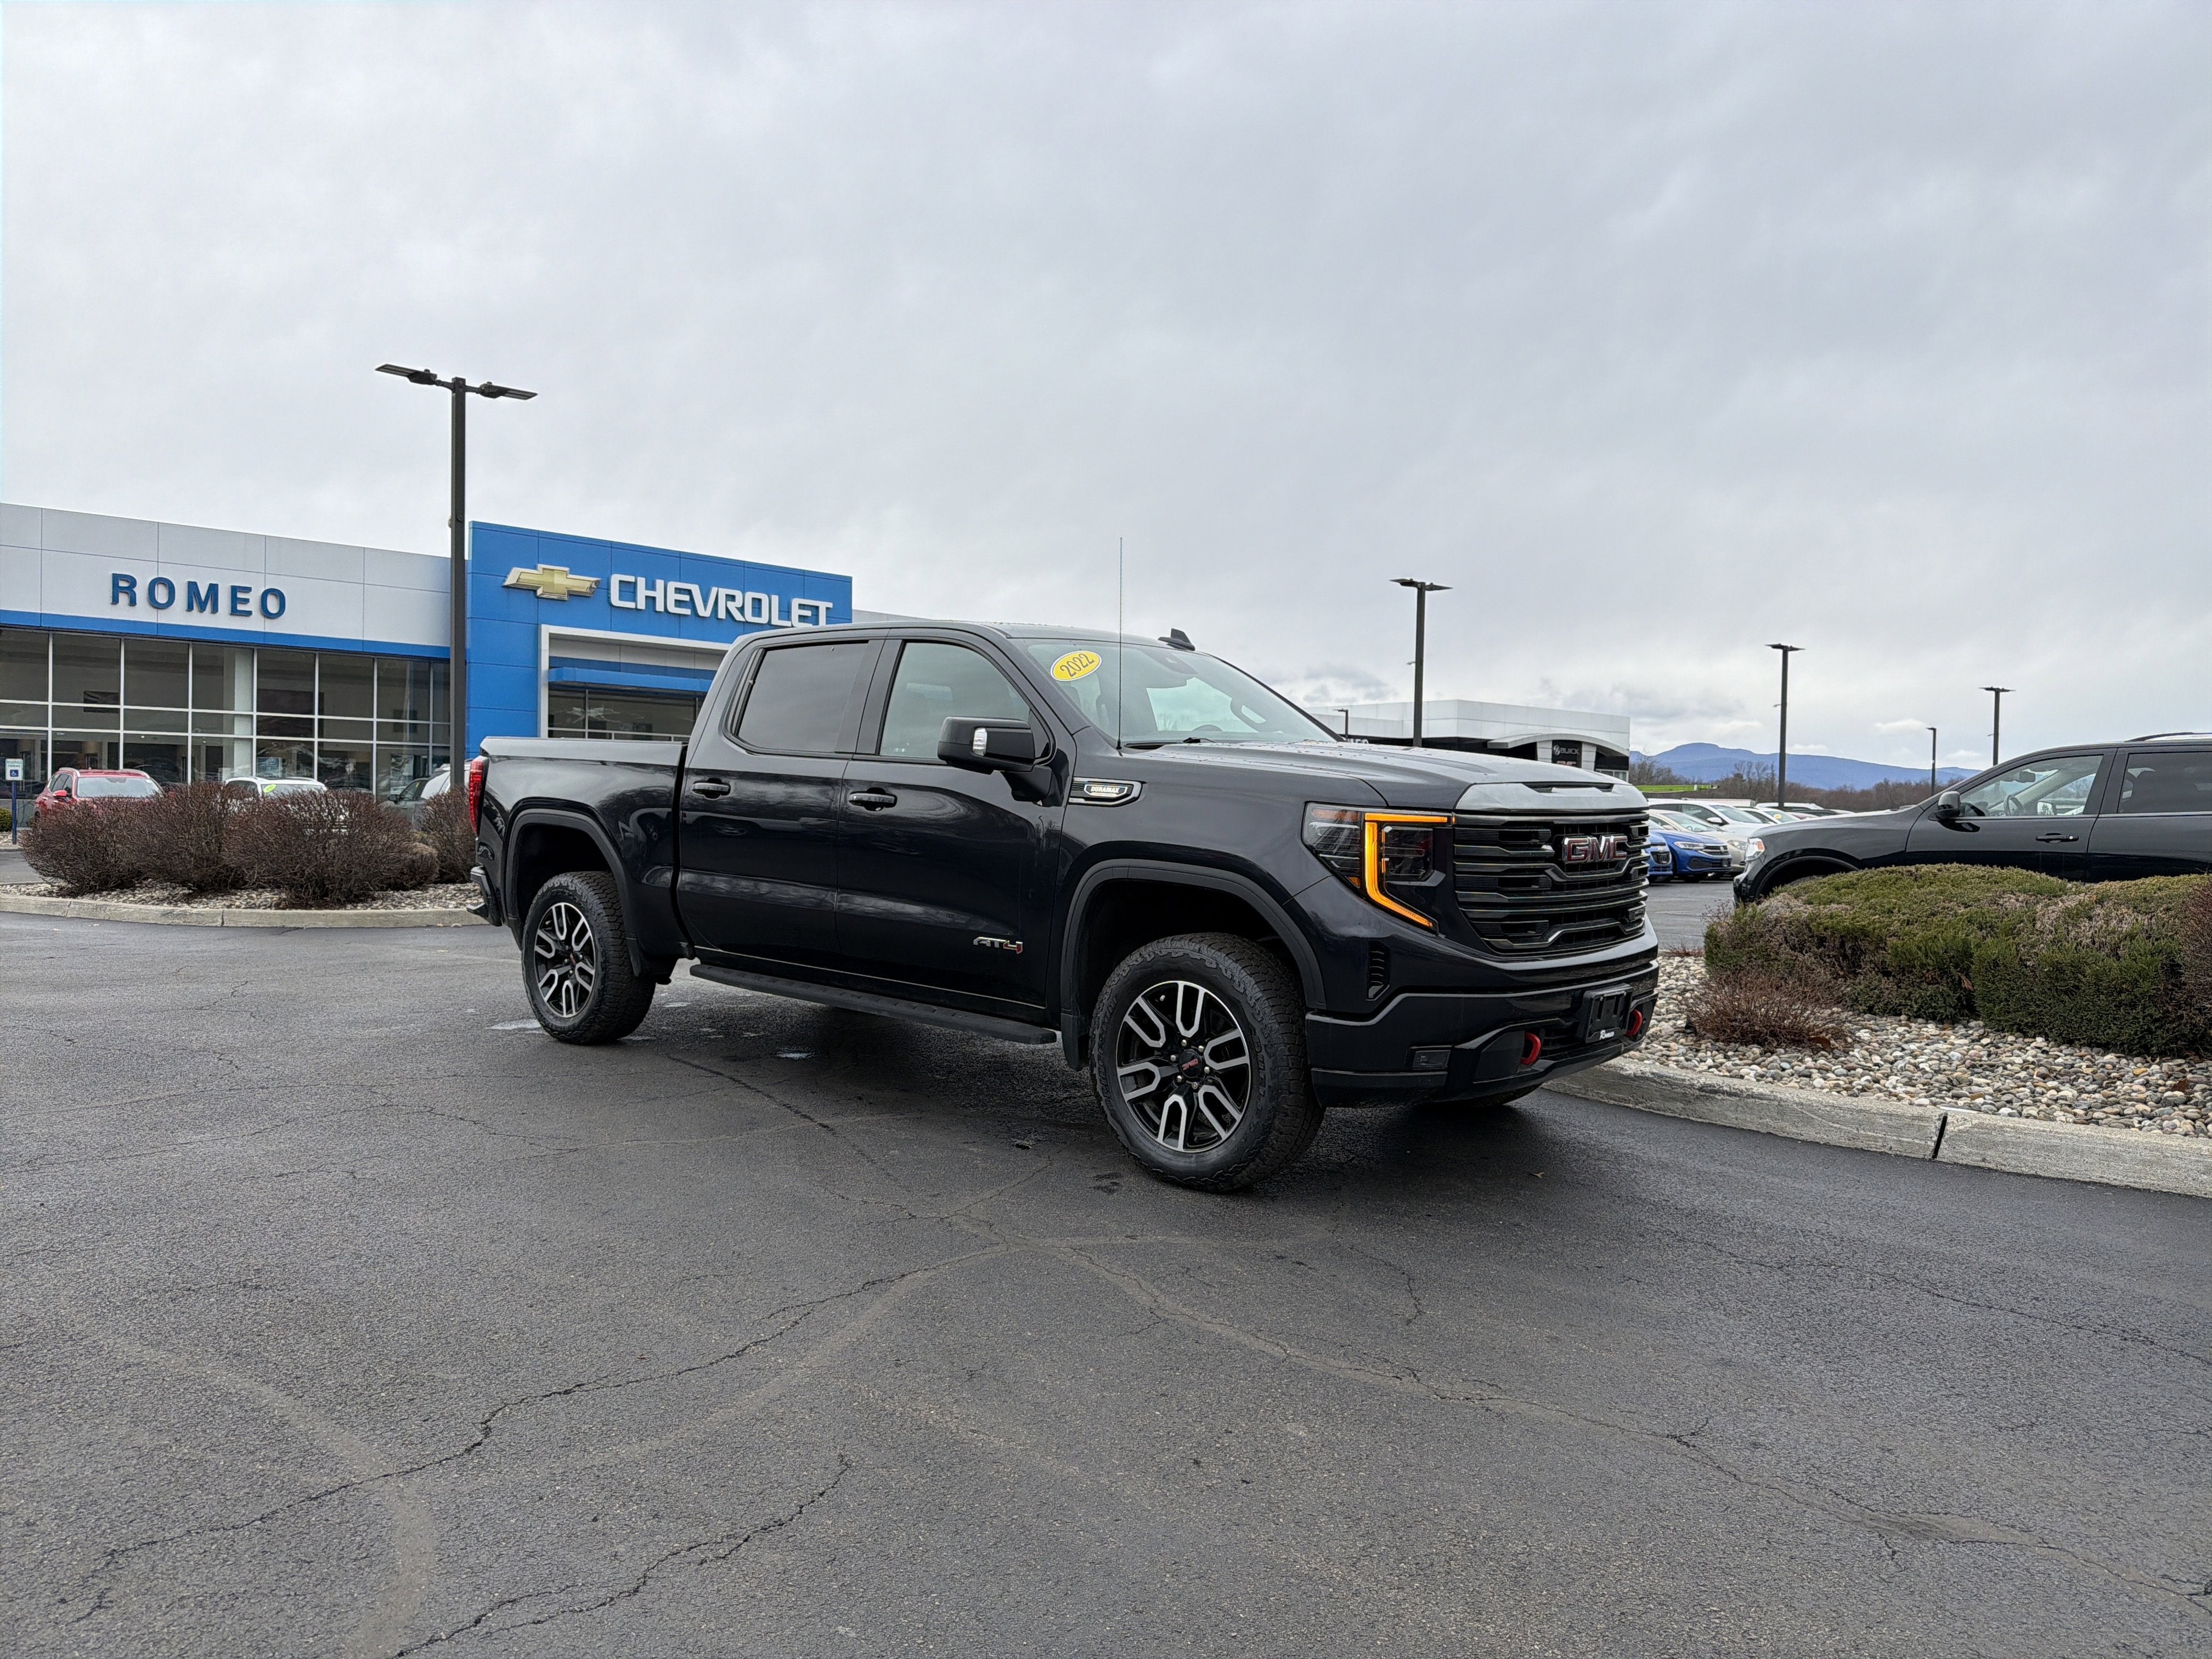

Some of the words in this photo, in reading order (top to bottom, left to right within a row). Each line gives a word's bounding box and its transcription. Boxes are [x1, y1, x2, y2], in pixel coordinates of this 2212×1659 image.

[110, 573, 286, 619] ROMEO
[610, 574, 833, 627] CHEVROLET
[1060, 653, 1095, 678] 2022
[1562, 835, 1628, 864] GMC
[973, 936, 1024, 955] AT4
